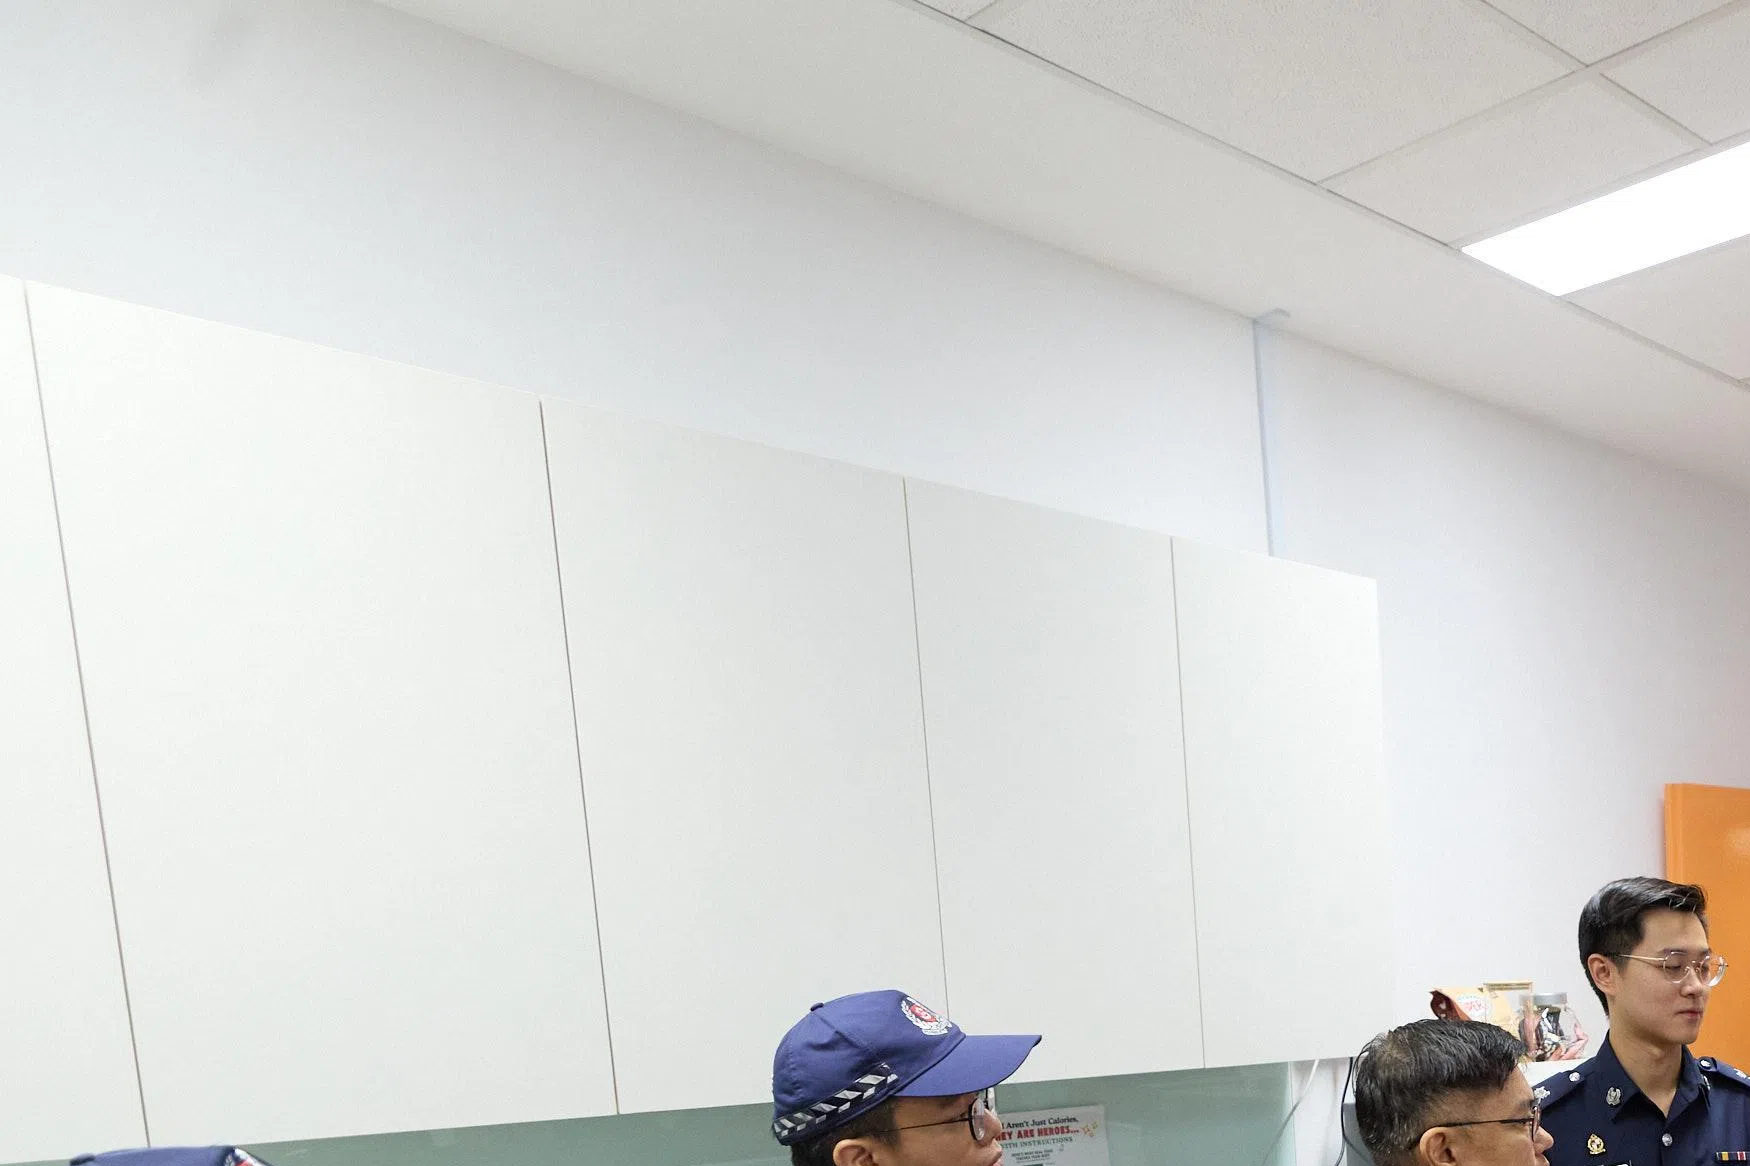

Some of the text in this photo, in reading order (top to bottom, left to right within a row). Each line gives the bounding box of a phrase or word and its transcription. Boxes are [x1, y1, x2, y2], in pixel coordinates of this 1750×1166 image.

[1006, 1119, 1029, 1129] Aren't
[1031, 1118, 1046, 1126] Just
[1017, 1129, 1034, 1139] ARE
[1020, 1136, 1073, 1148] INSTRUCTIONS
